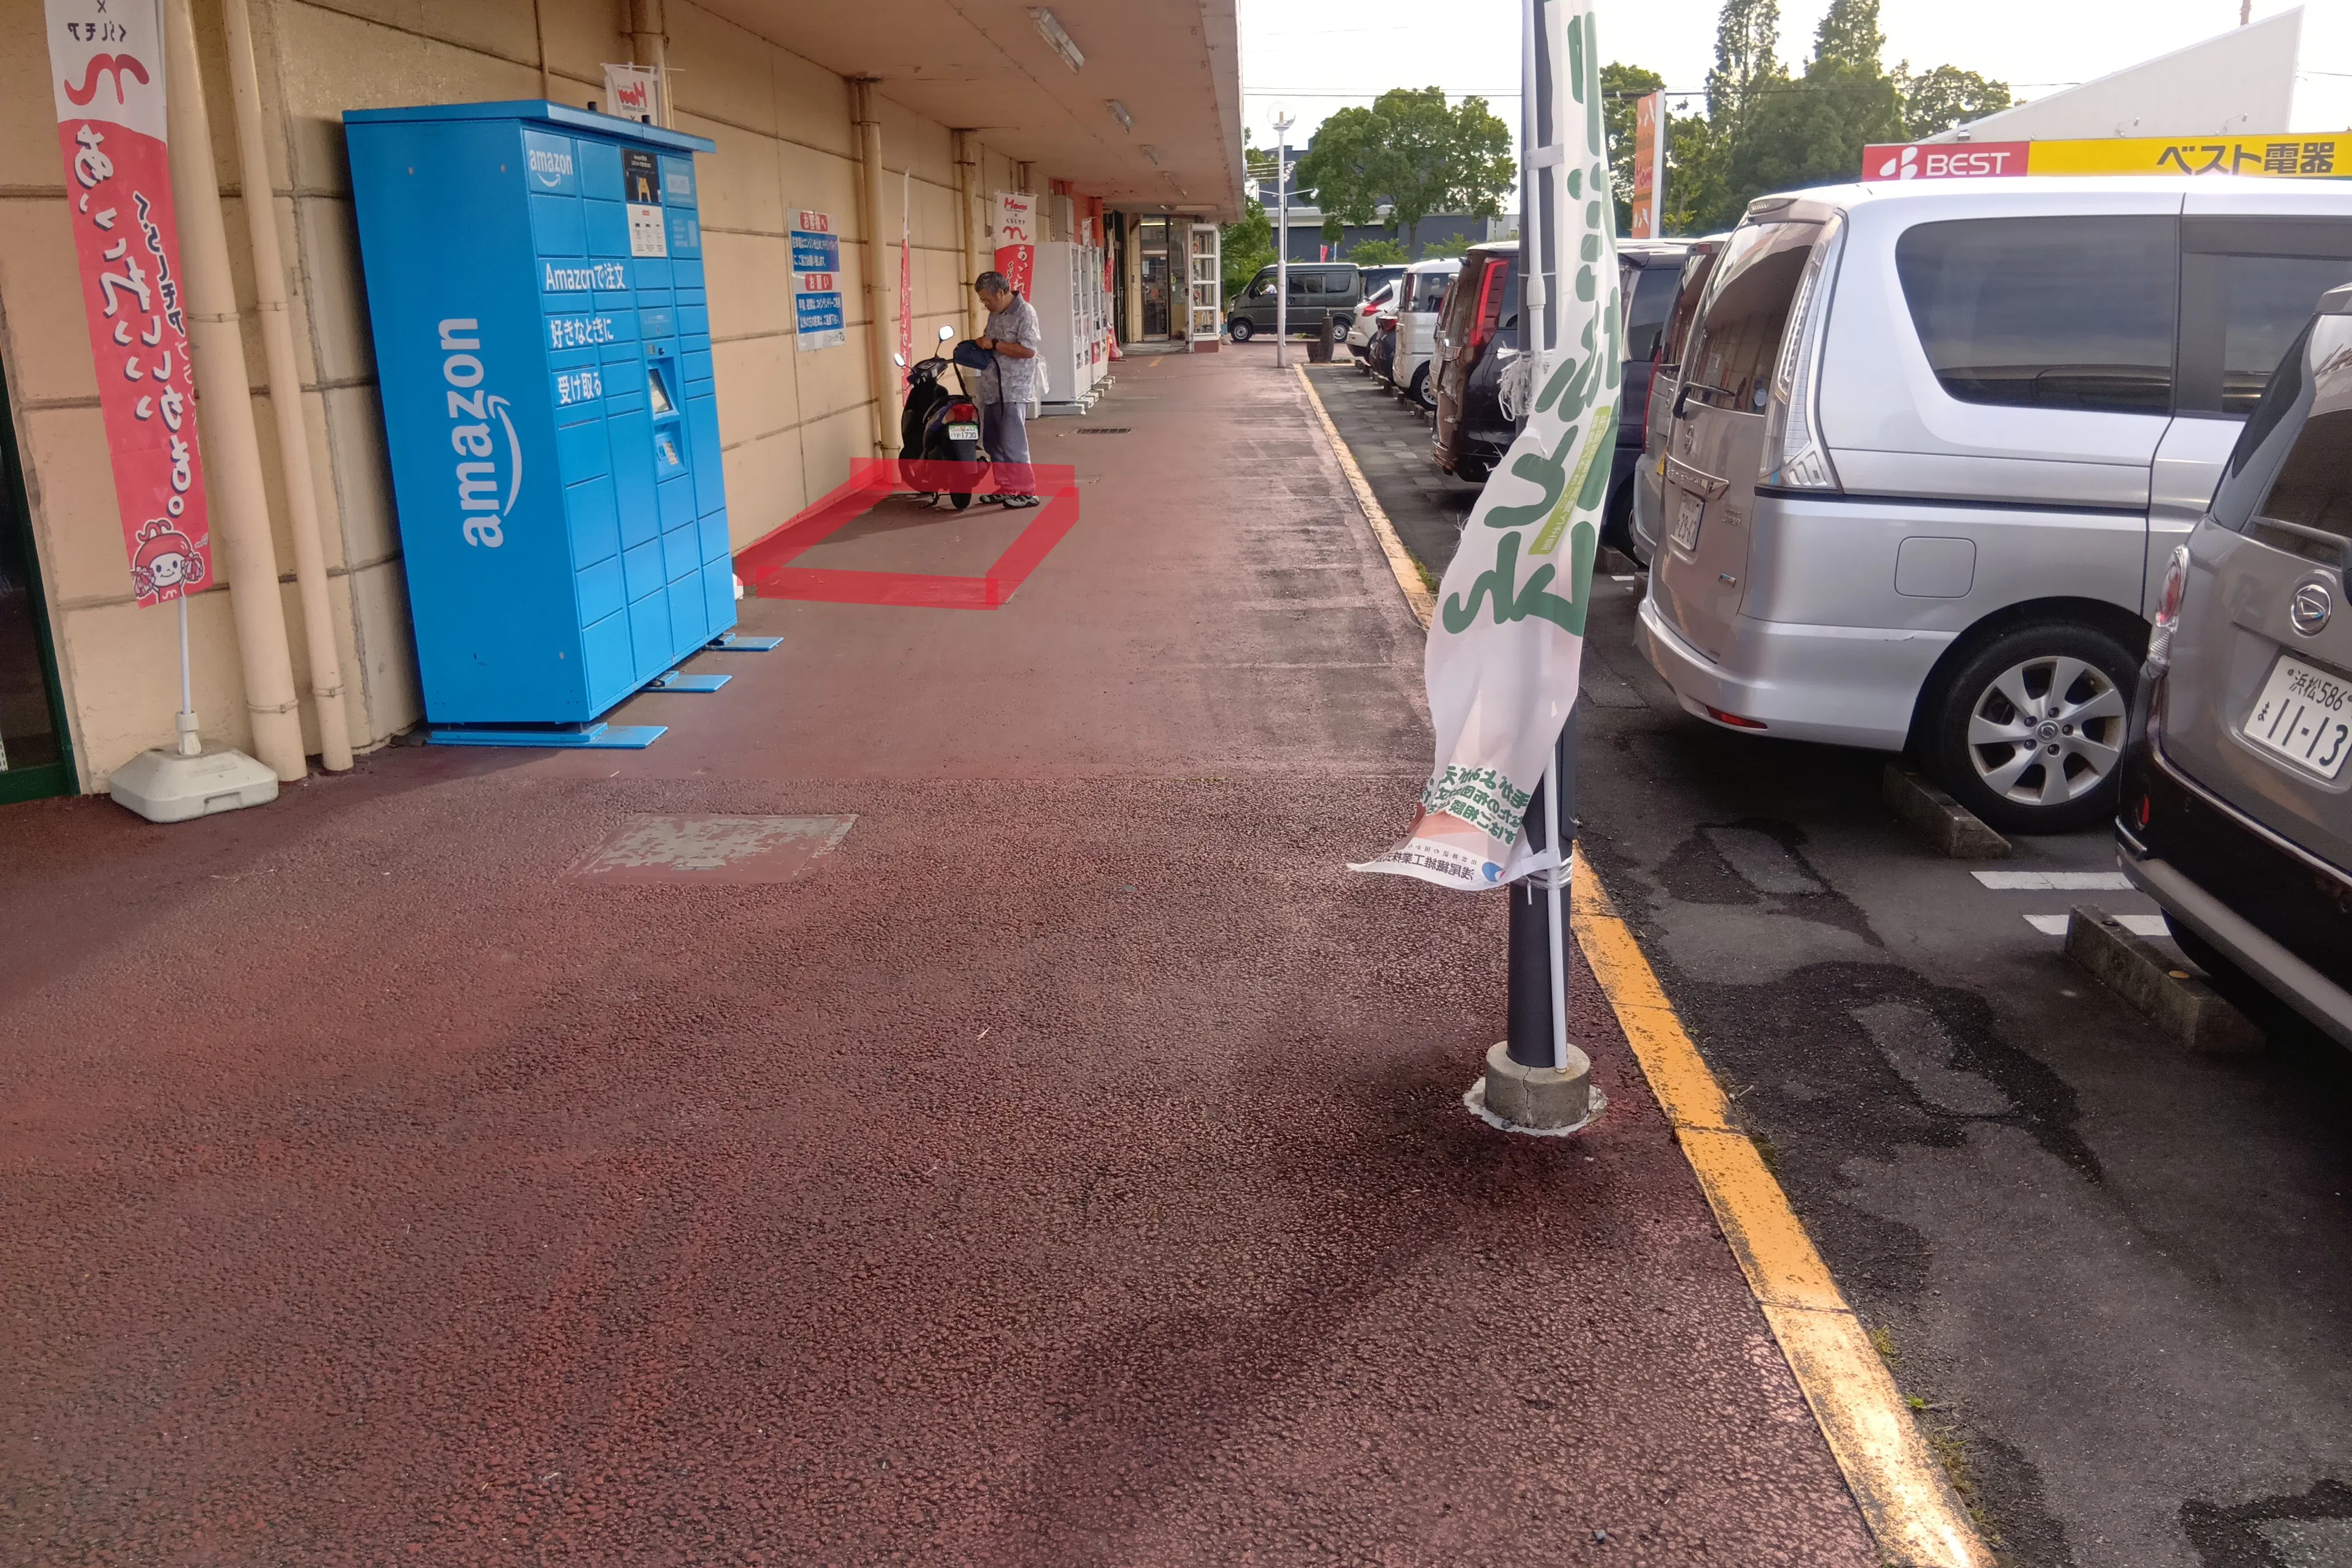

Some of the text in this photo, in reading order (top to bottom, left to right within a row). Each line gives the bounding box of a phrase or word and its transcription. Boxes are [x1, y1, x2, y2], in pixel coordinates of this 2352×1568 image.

[529, 148, 573, 176] amazon
[1926, 152, 2011, 176] BEST
[2156, 142, 2335, 176] ベスト電器
[546, 262, 625, 290] Amazonで注文
[551, 318, 614, 349] 好きなときに
[558, 372, 602, 404] 受け取る
[438, 318, 504, 548] amazon
[2267, 698, 2348, 766] 11-13
